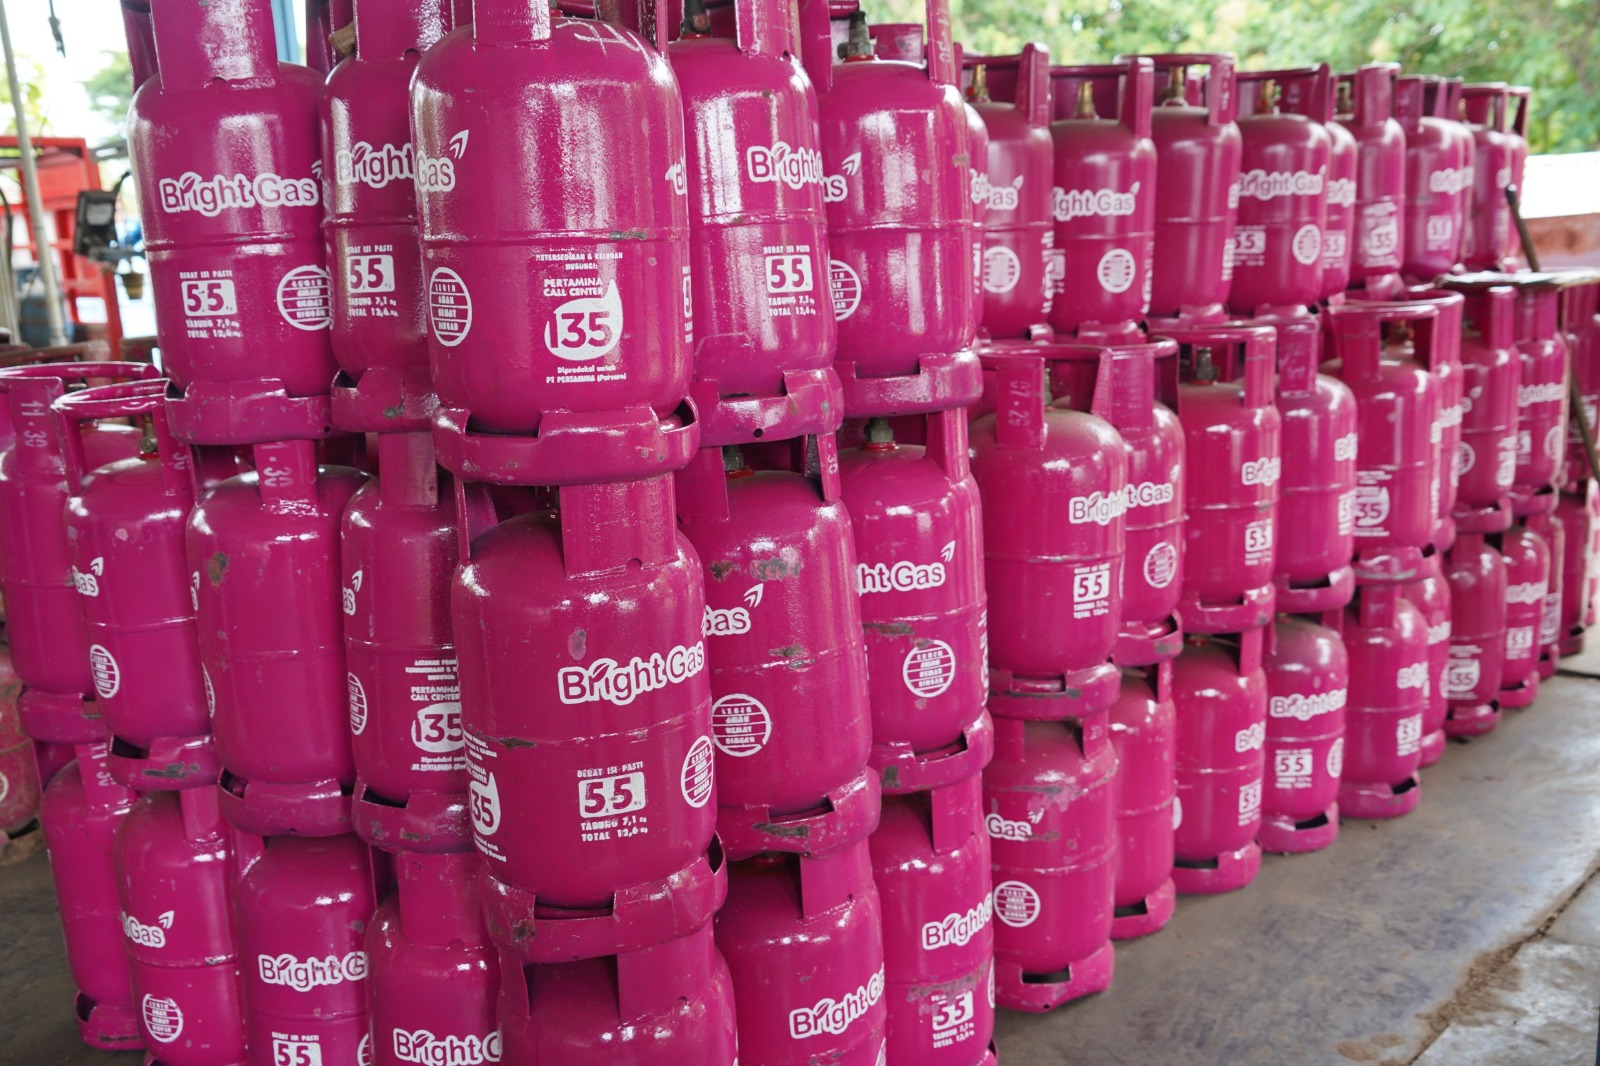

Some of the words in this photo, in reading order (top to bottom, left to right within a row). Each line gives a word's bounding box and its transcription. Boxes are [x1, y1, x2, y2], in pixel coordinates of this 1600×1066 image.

[543, 288, 567, 297] CALL
[569, 286, 603, 296] CENTER
[544, 277, 603, 288] PERTAMINA
[550, 311, 613, 349] 135
[890, 561, 946, 592] Gas
[558, 658, 667, 706] Bright
[411, 694, 430, 702] CALL
[622, 761, 644, 773] PASTI
[622, 816, 637, 828] 7,1
[985, 813, 1032, 842] Gas
[581, 831, 610, 842] TOTAL
[617, 826, 639, 838] 12,6
[258, 953, 343, 992] Bright
[789, 986, 869, 1039] Bright
